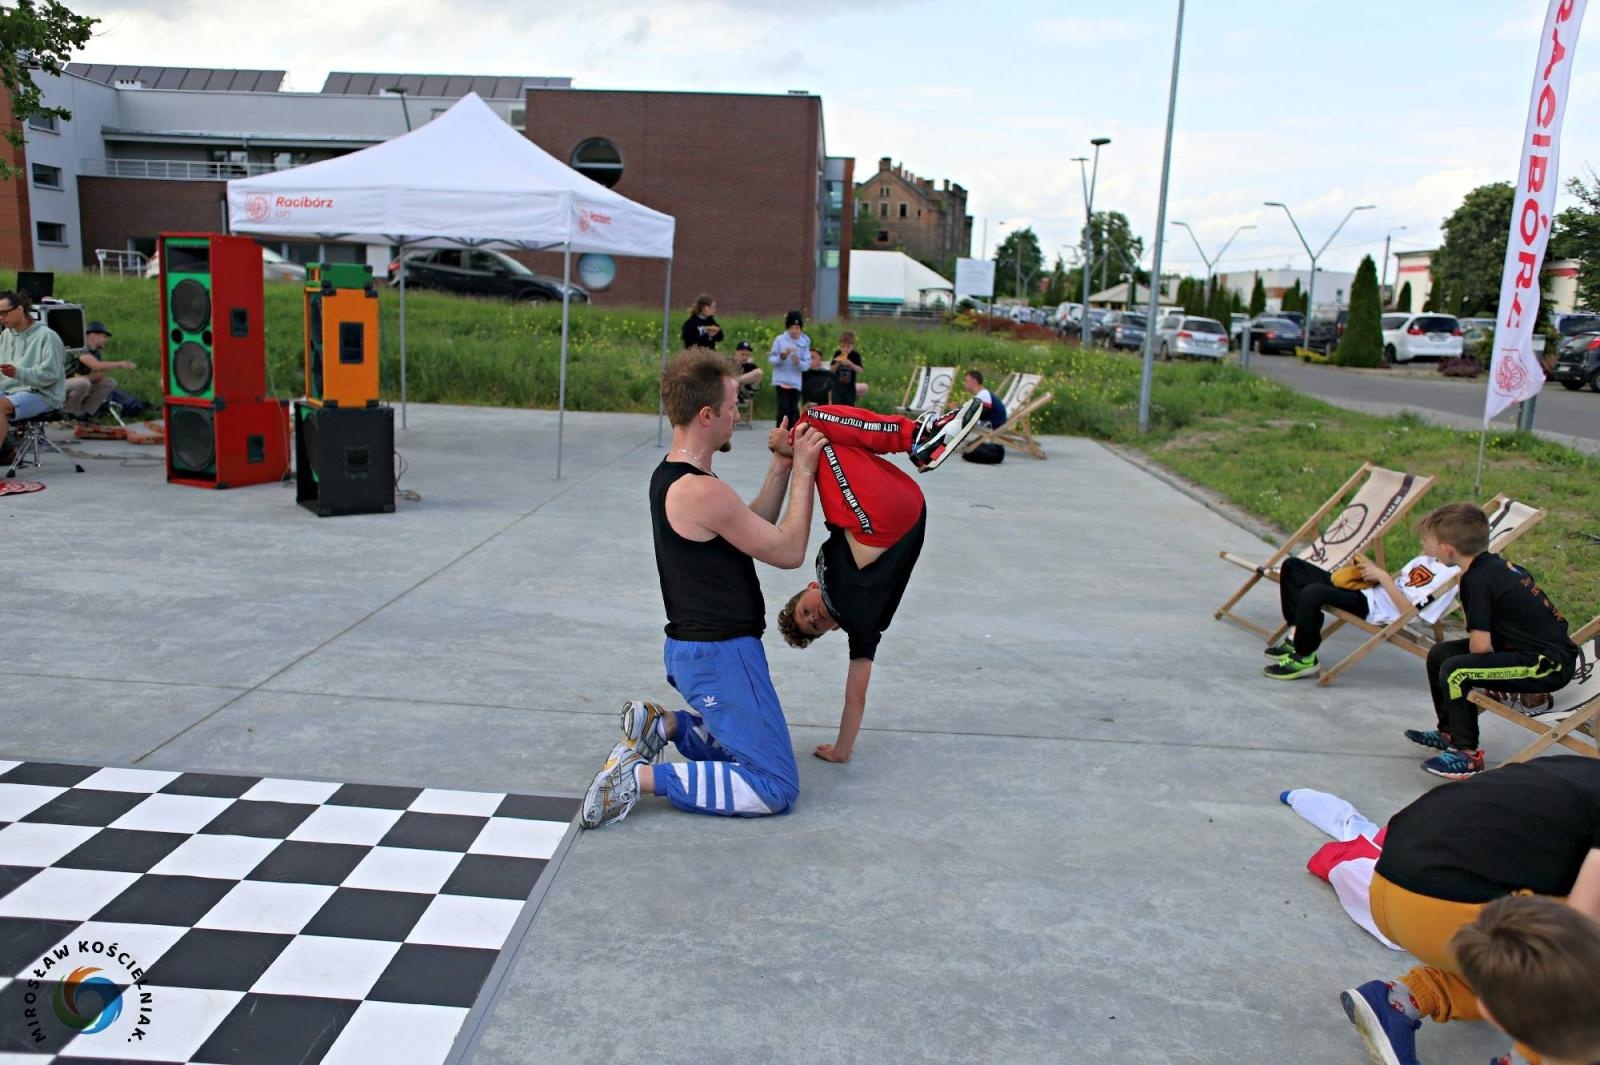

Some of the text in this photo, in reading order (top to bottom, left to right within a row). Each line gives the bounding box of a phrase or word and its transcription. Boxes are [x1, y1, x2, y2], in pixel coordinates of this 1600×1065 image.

[275, 196, 334, 208] Racibórz
[820, 411, 840, 423] URBAN
[840, 417, 863, 429] UTILITY
[863, 421, 882, 431] URBAN
[824, 445, 870, 529] URBAN UTILITY URBAN UTILITY
